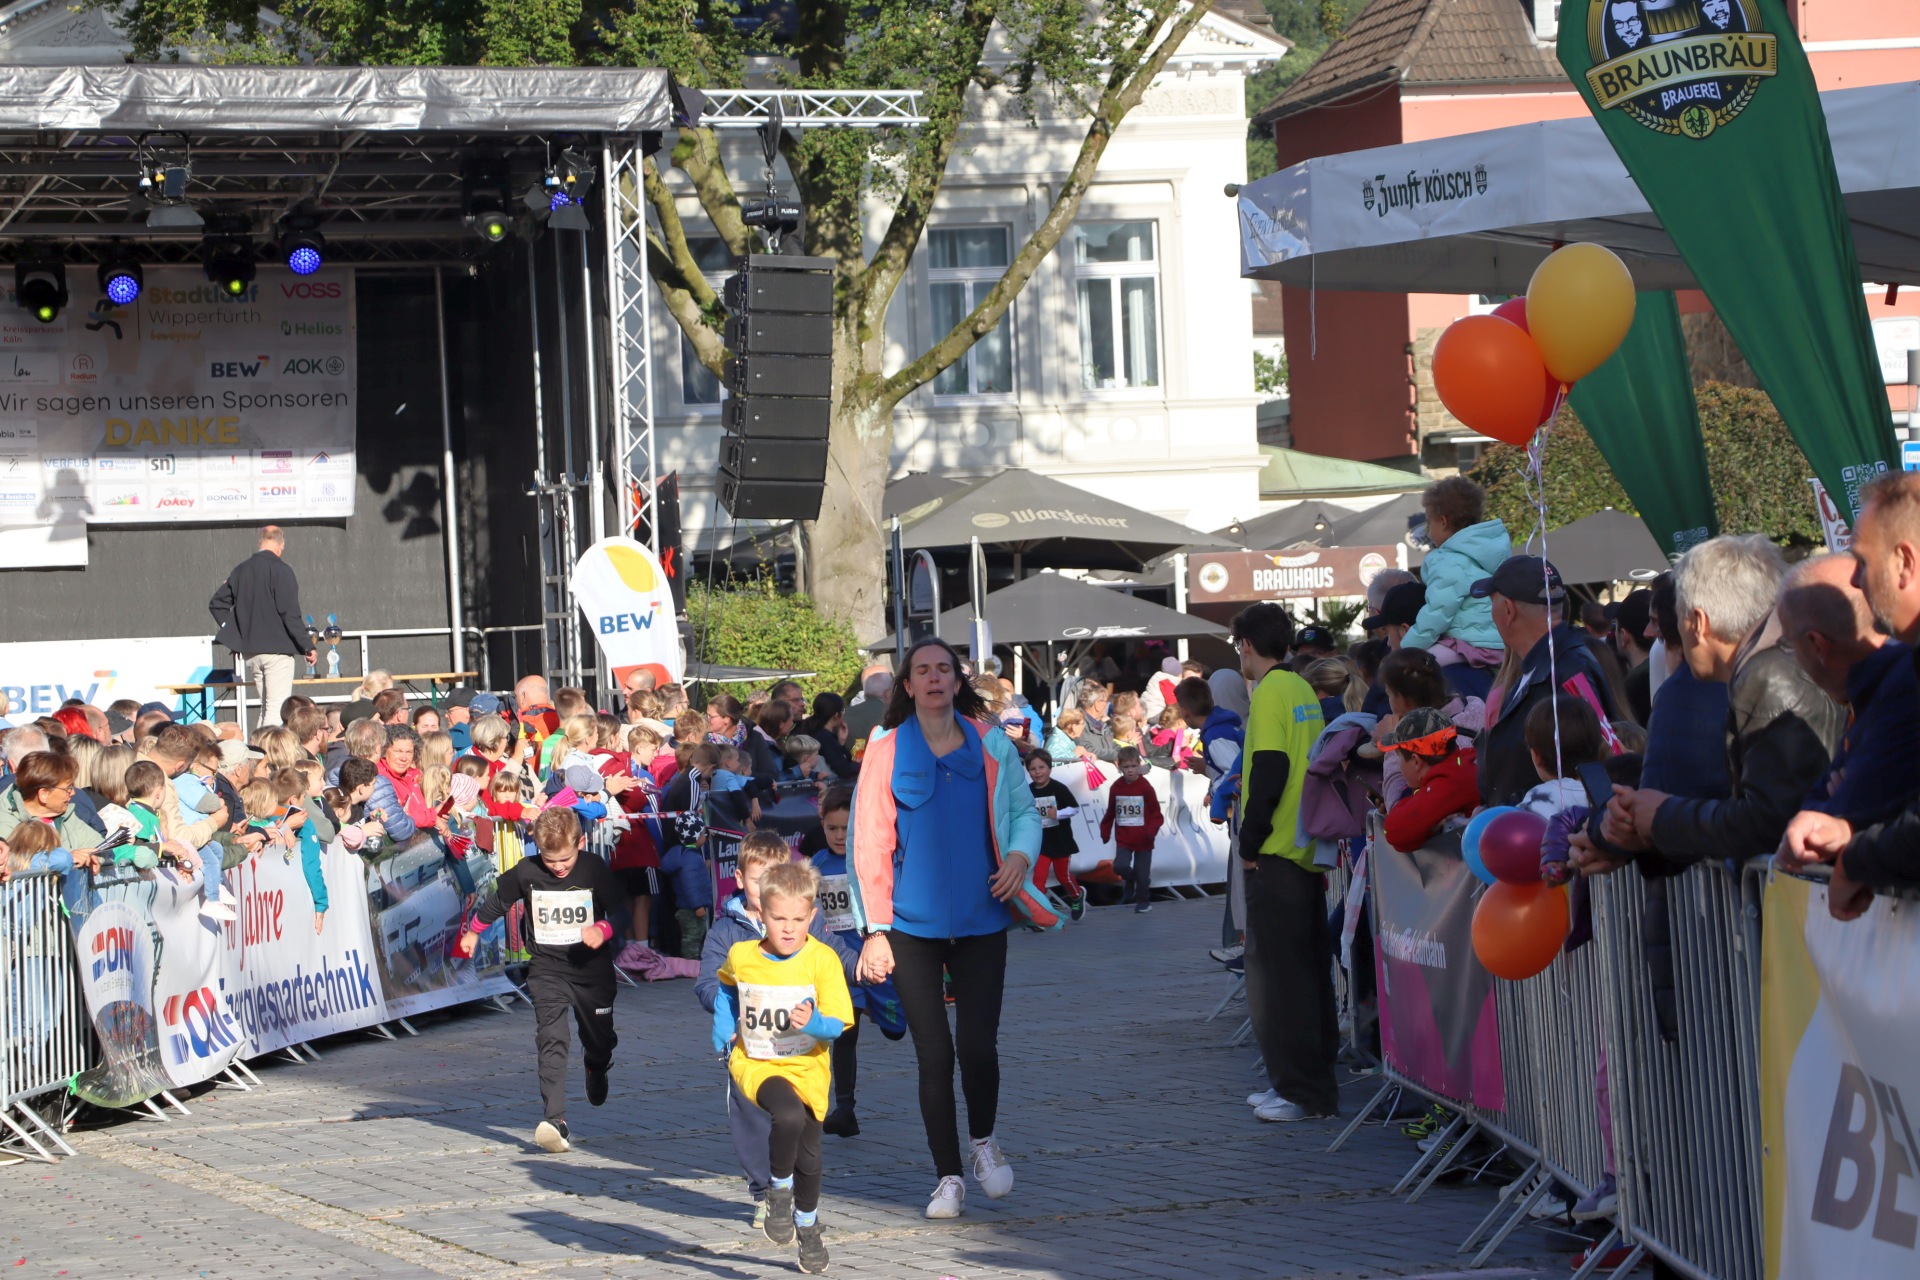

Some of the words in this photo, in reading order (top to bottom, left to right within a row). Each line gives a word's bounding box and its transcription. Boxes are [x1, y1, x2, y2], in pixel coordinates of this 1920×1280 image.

[1598, 35, 1768, 99] BRAUNBRÄU
[1661, 81, 1721, 111] BRAUEREI
[1424, 168, 1472, 204] KÖLSCH
[280, 282, 341, 299] VOSS
[148, 308, 262, 327] Wipperfürth
[3, 325, 64, 334] Kreissparkasse
[294, 322, 343, 335] Helios
[211, 361, 260, 378] BEW
[282, 358, 324, 375] AOK
[37, 396, 111, 415] sagen
[119, 395, 215, 410] unseren
[223, 390, 348, 412] Sponsoren
[105, 415, 241, 447] DANKE
[206, 494, 247, 502] BONGEN
[271, 486, 297, 496] ONI
[156, 496, 195, 509] jokey
[1011, 507, 1129, 528] Warsteiner
[1253, 566, 1334, 591] BRAUHAUS
[599, 609, 654, 635] BEW
[0, 682, 100, 715] BEW
[1116, 804, 1141, 815] 6193
[236, 856, 284, 972] Jahre
[538, 906, 588, 925] 5499
[106, 926, 134, 975] ONI
[1811, 1062, 1920, 1251] BE
